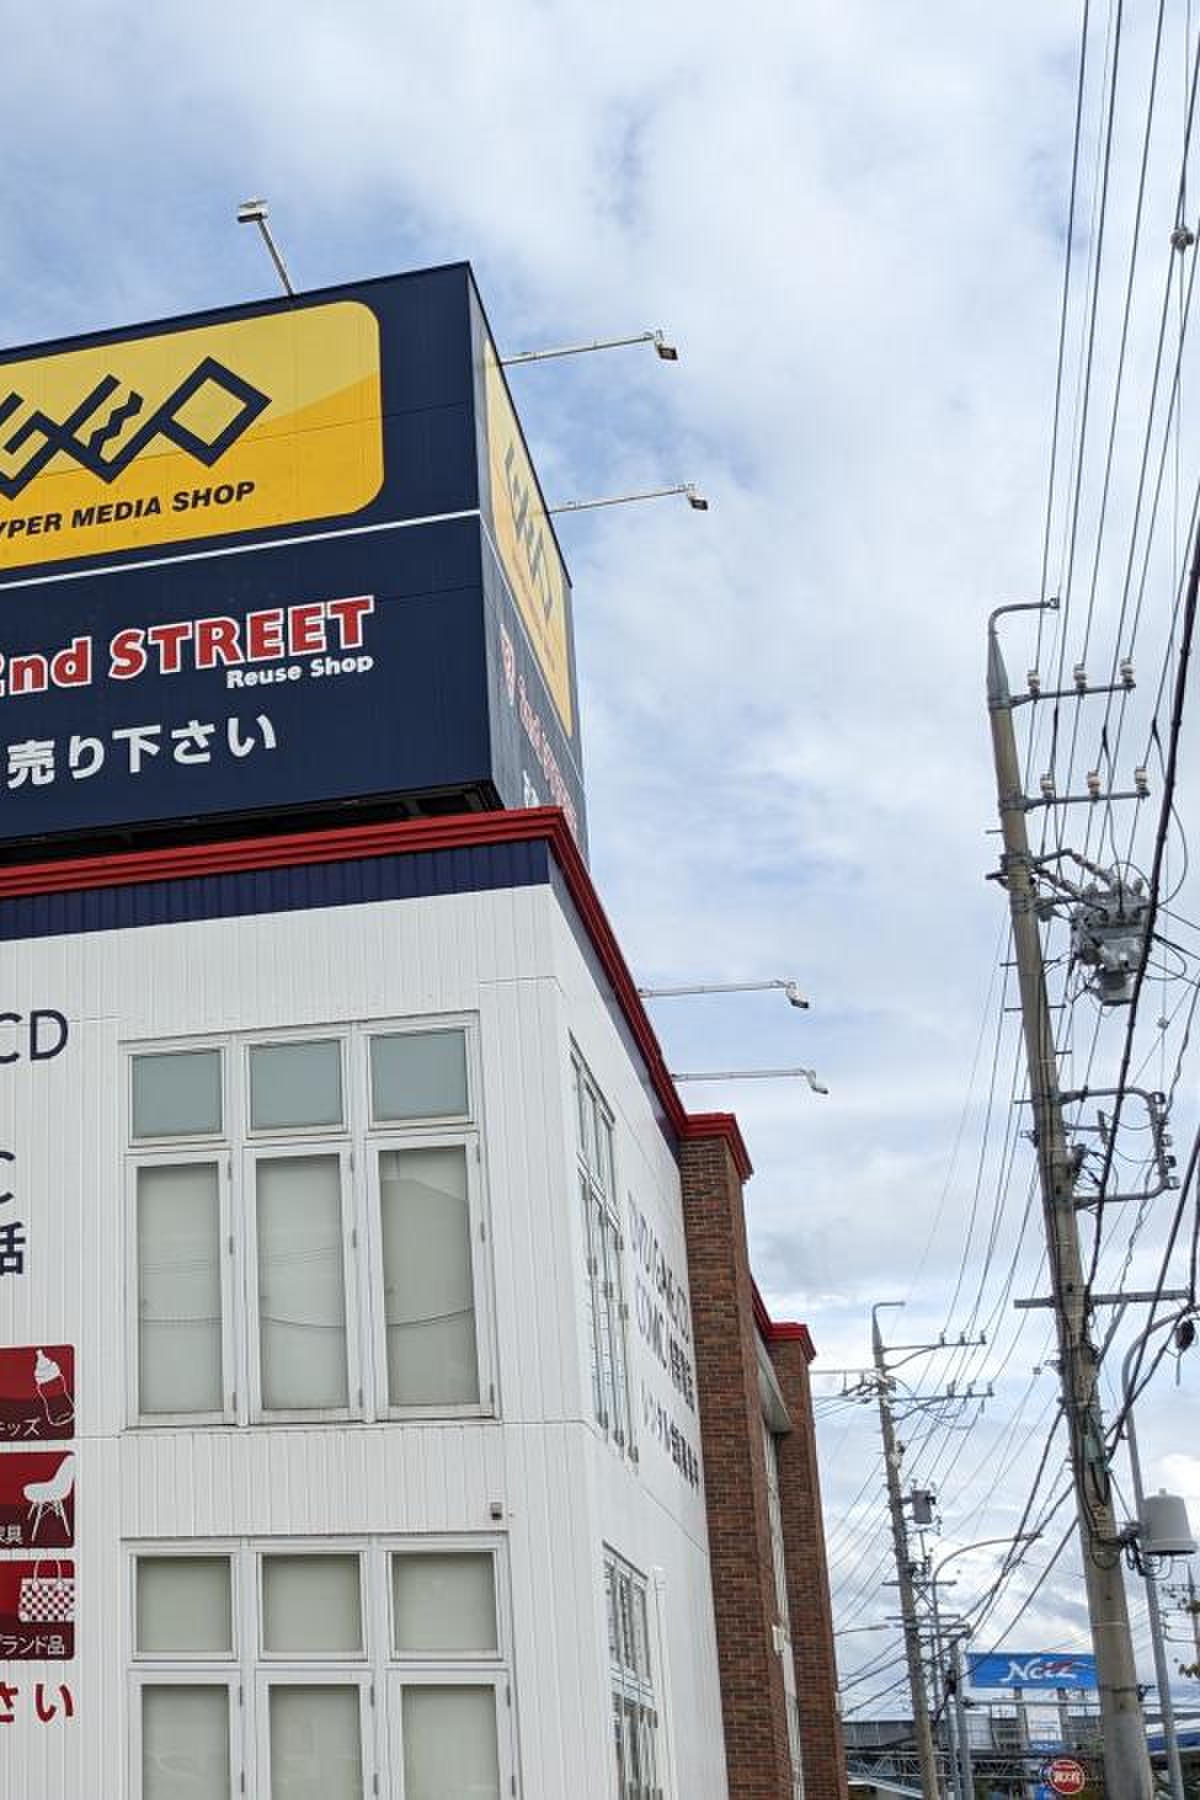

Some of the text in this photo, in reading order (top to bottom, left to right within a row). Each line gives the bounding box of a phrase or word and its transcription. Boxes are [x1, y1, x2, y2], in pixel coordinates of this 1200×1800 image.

[71, 496, 161, 529] MEDIA
[172, 481, 255, 512] SHOP
[108, 595, 375, 680] STREET
[226, 655, 374, 688] Reuse Shop
